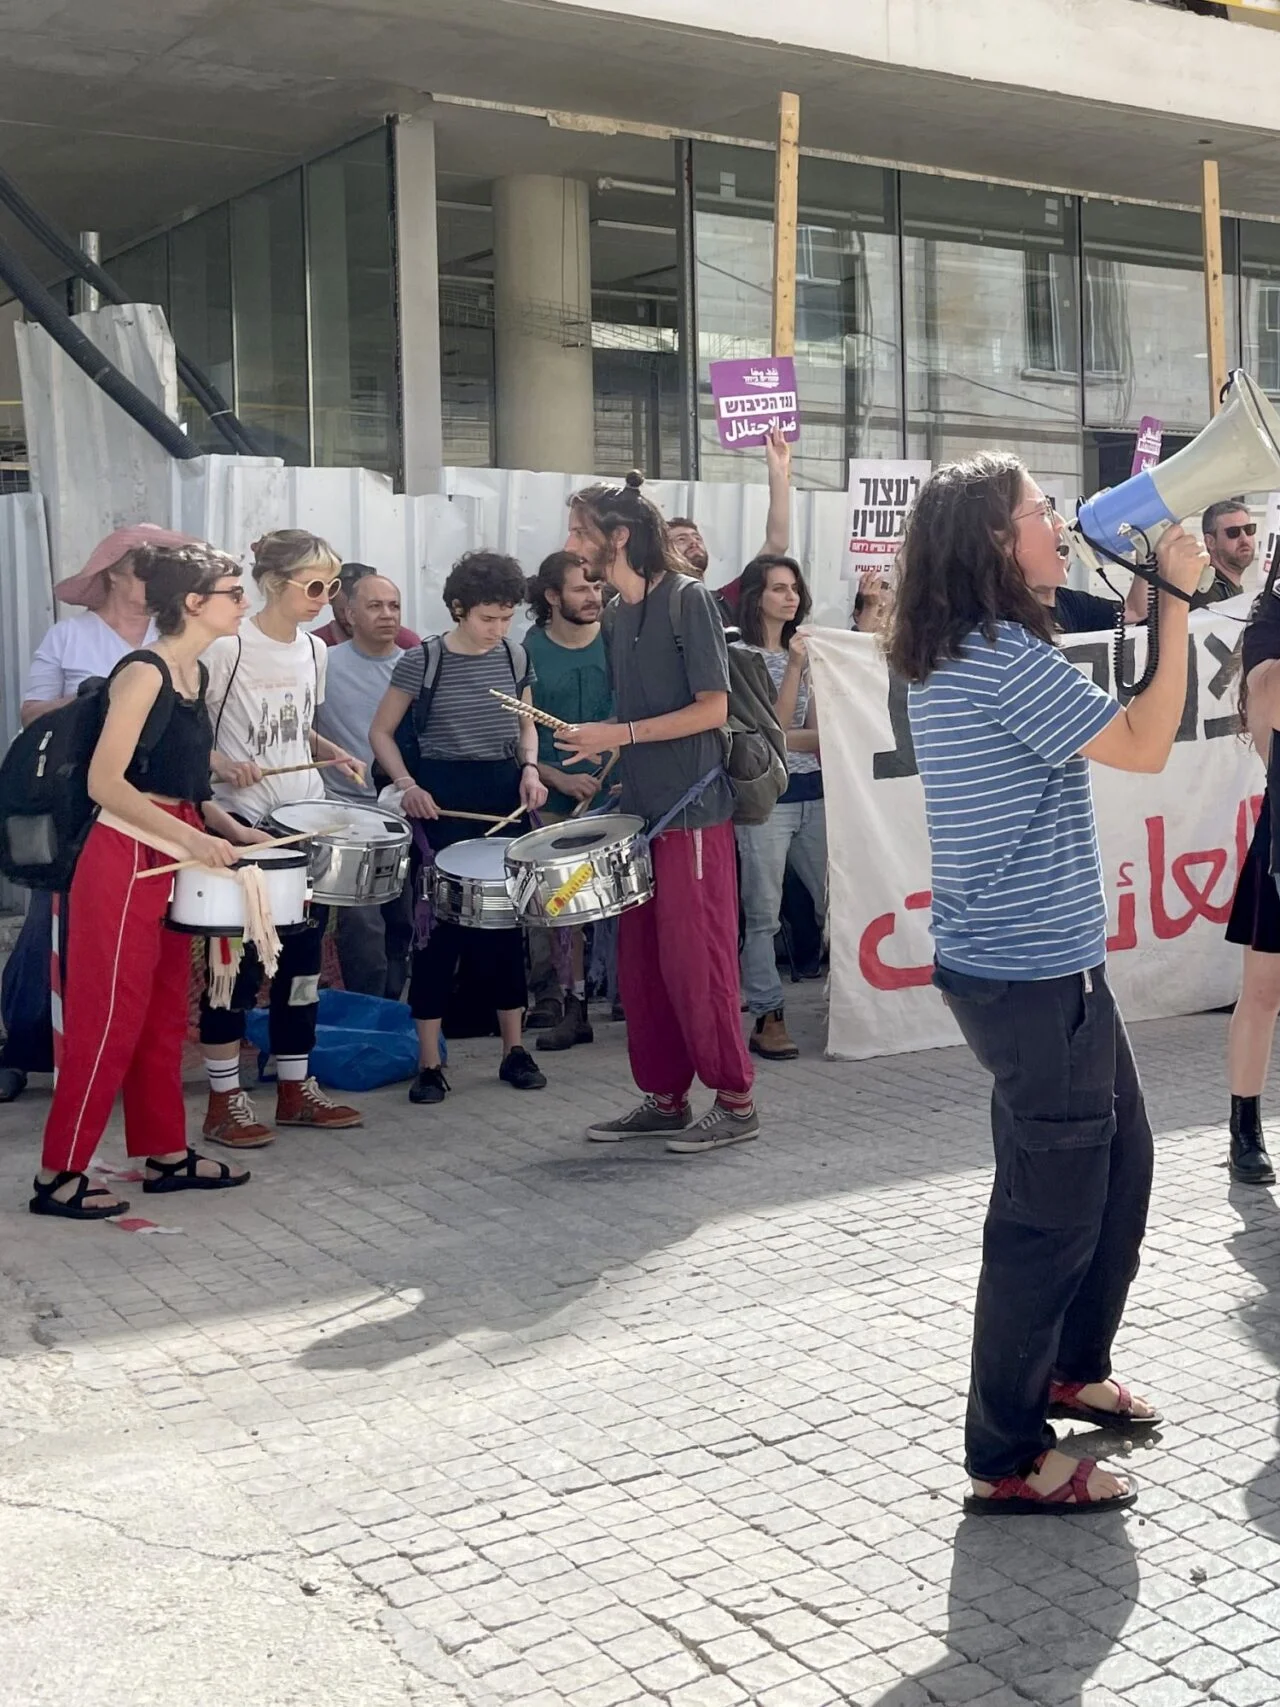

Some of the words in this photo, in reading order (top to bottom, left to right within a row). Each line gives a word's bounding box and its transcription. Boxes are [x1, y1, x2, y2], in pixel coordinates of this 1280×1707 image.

[725, 396, 778, 414] הכיבוש
[779, 395, 793, 409] נגד
[852, 509, 906, 537] כשיו!
